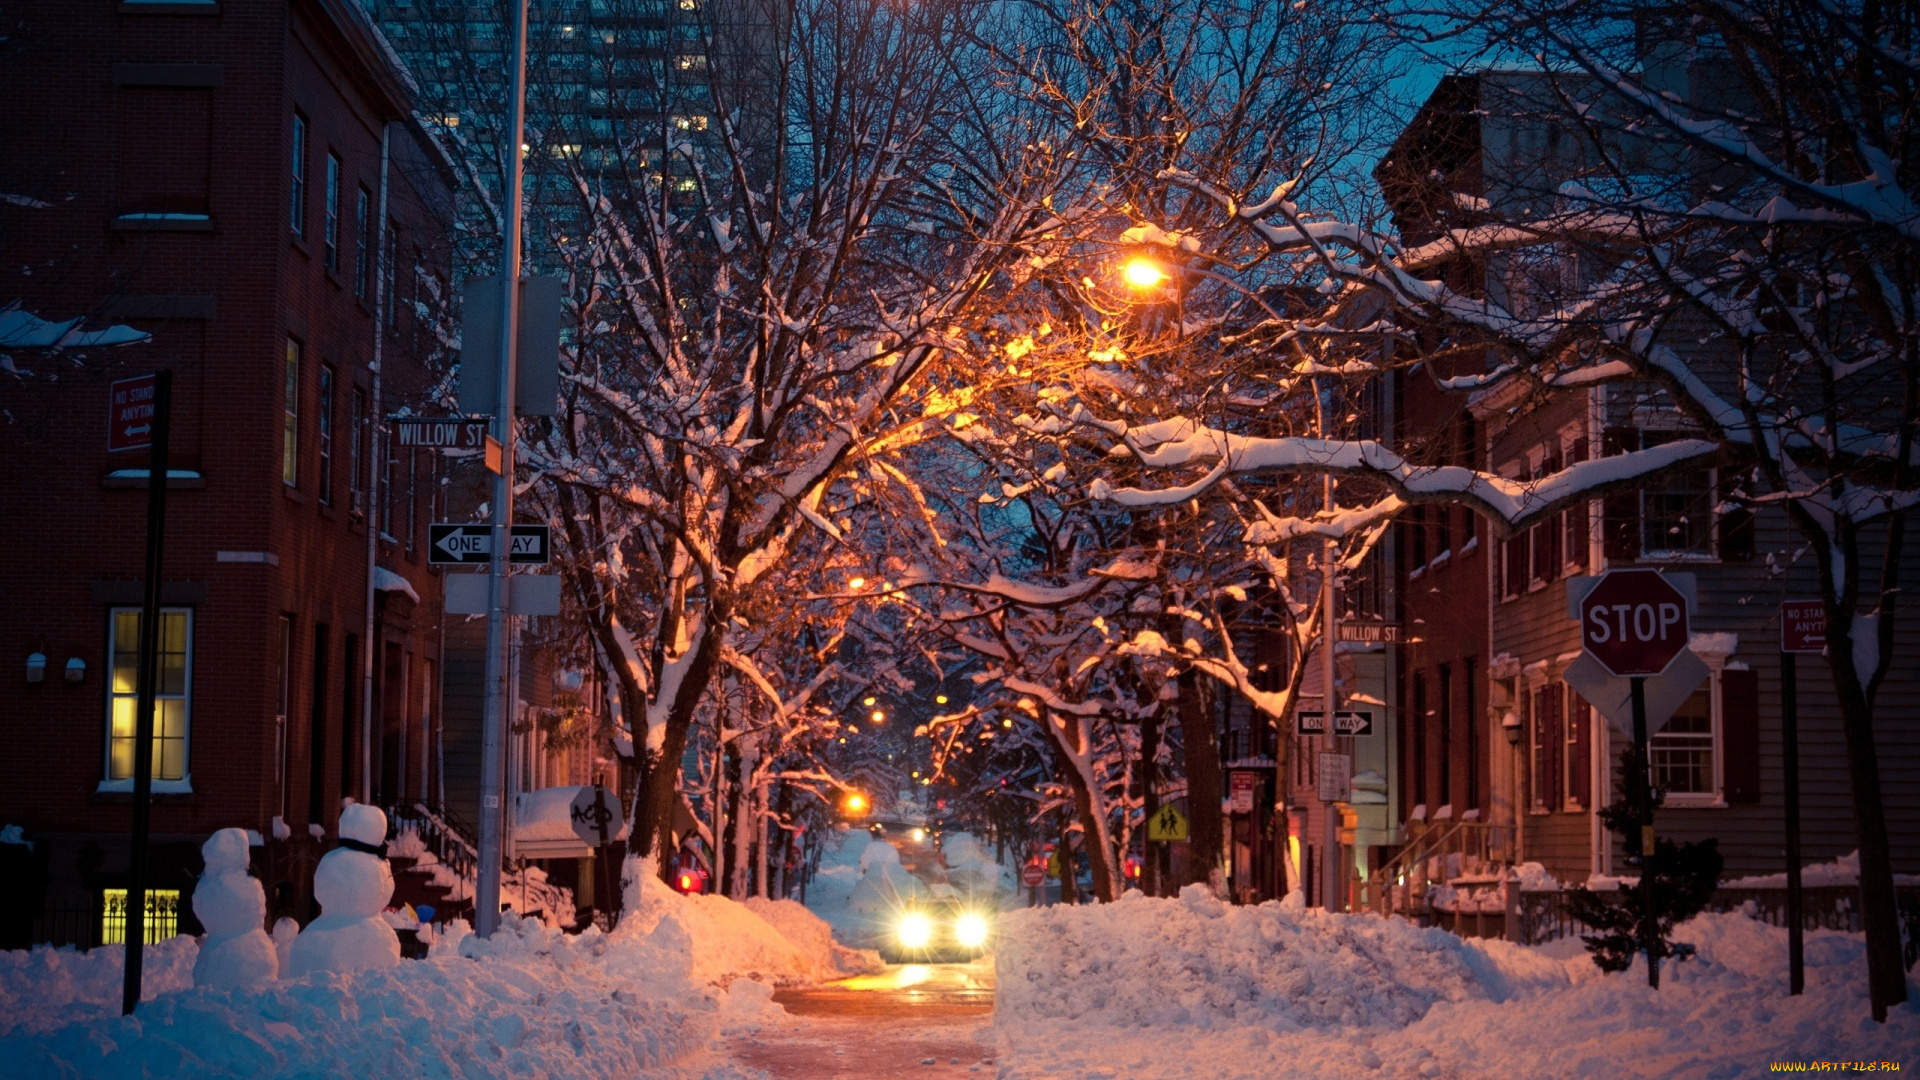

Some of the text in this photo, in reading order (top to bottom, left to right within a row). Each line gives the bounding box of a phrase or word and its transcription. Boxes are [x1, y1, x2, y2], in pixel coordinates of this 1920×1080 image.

[116, 390, 127, 405] NO
[399, 423, 485, 446] WILLOW ST
[448, 537, 533, 552] ONE AY
[1787, 609, 1800, 620] NO
[1589, 602, 1681, 644] STOP
[1342, 626, 1397, 642] WILLOW ST
[1308, 718, 1361, 729] ON WAY
